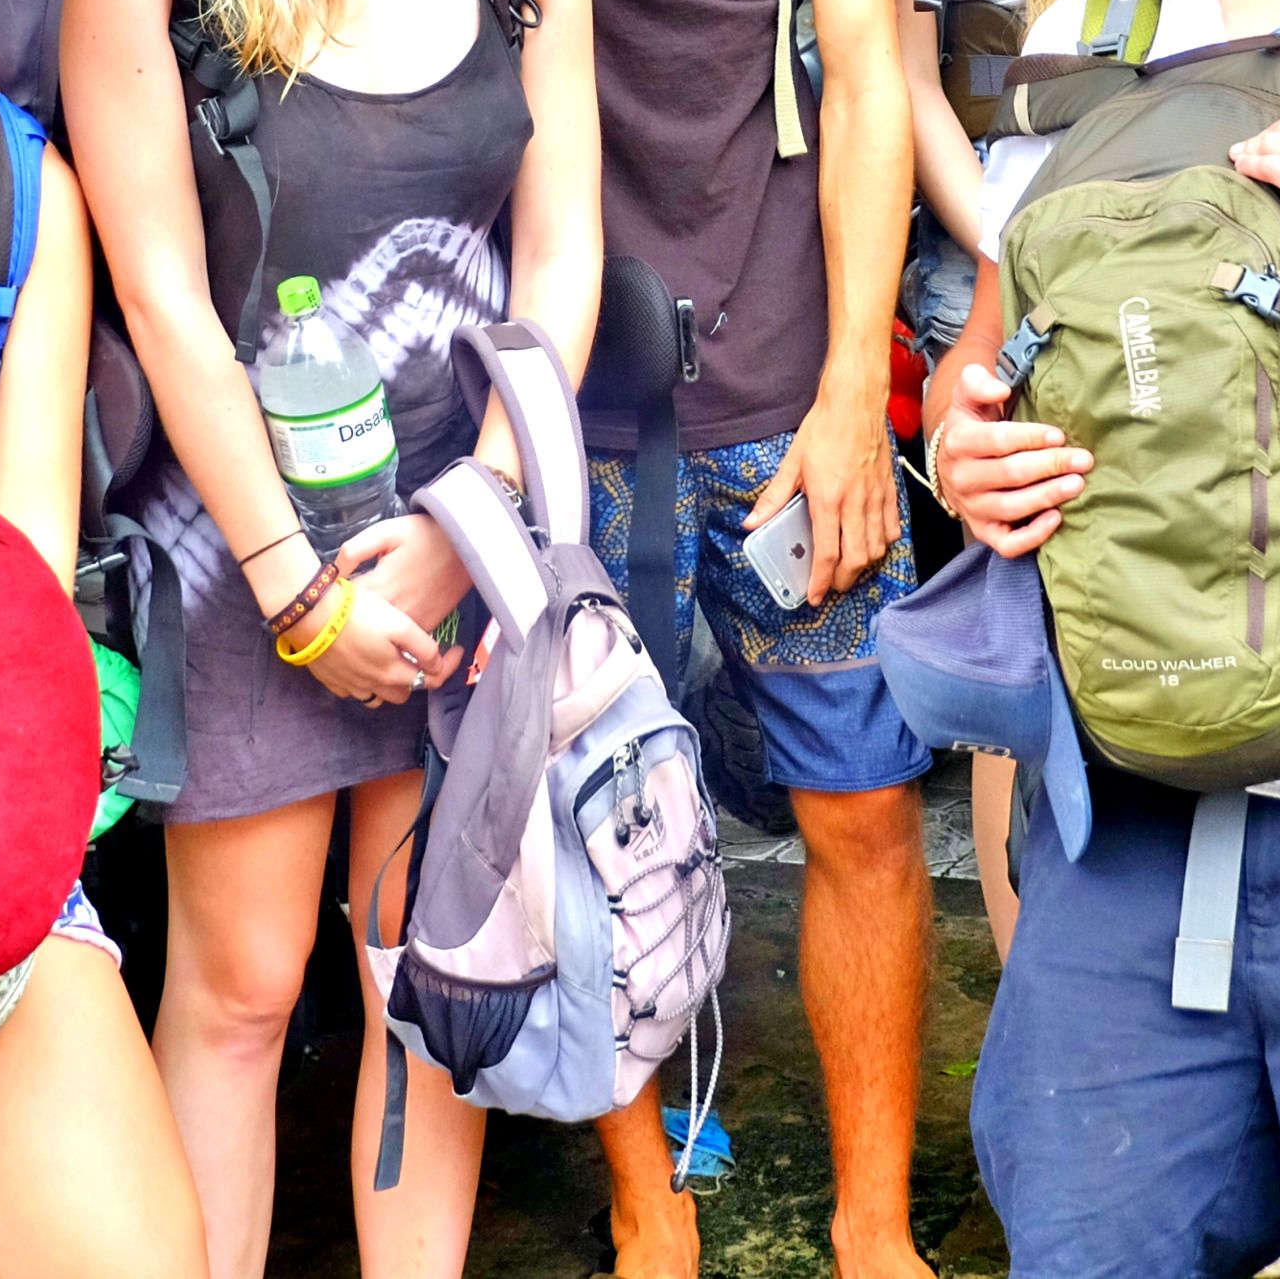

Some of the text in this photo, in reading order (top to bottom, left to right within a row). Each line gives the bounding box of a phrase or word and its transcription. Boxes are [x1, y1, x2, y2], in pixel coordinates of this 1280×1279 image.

[1119, 296, 1161, 417] CAMELBAK
[1101, 655, 1237, 671] CLOUD WALKER
[1158, 674, 1179, 687] 18
